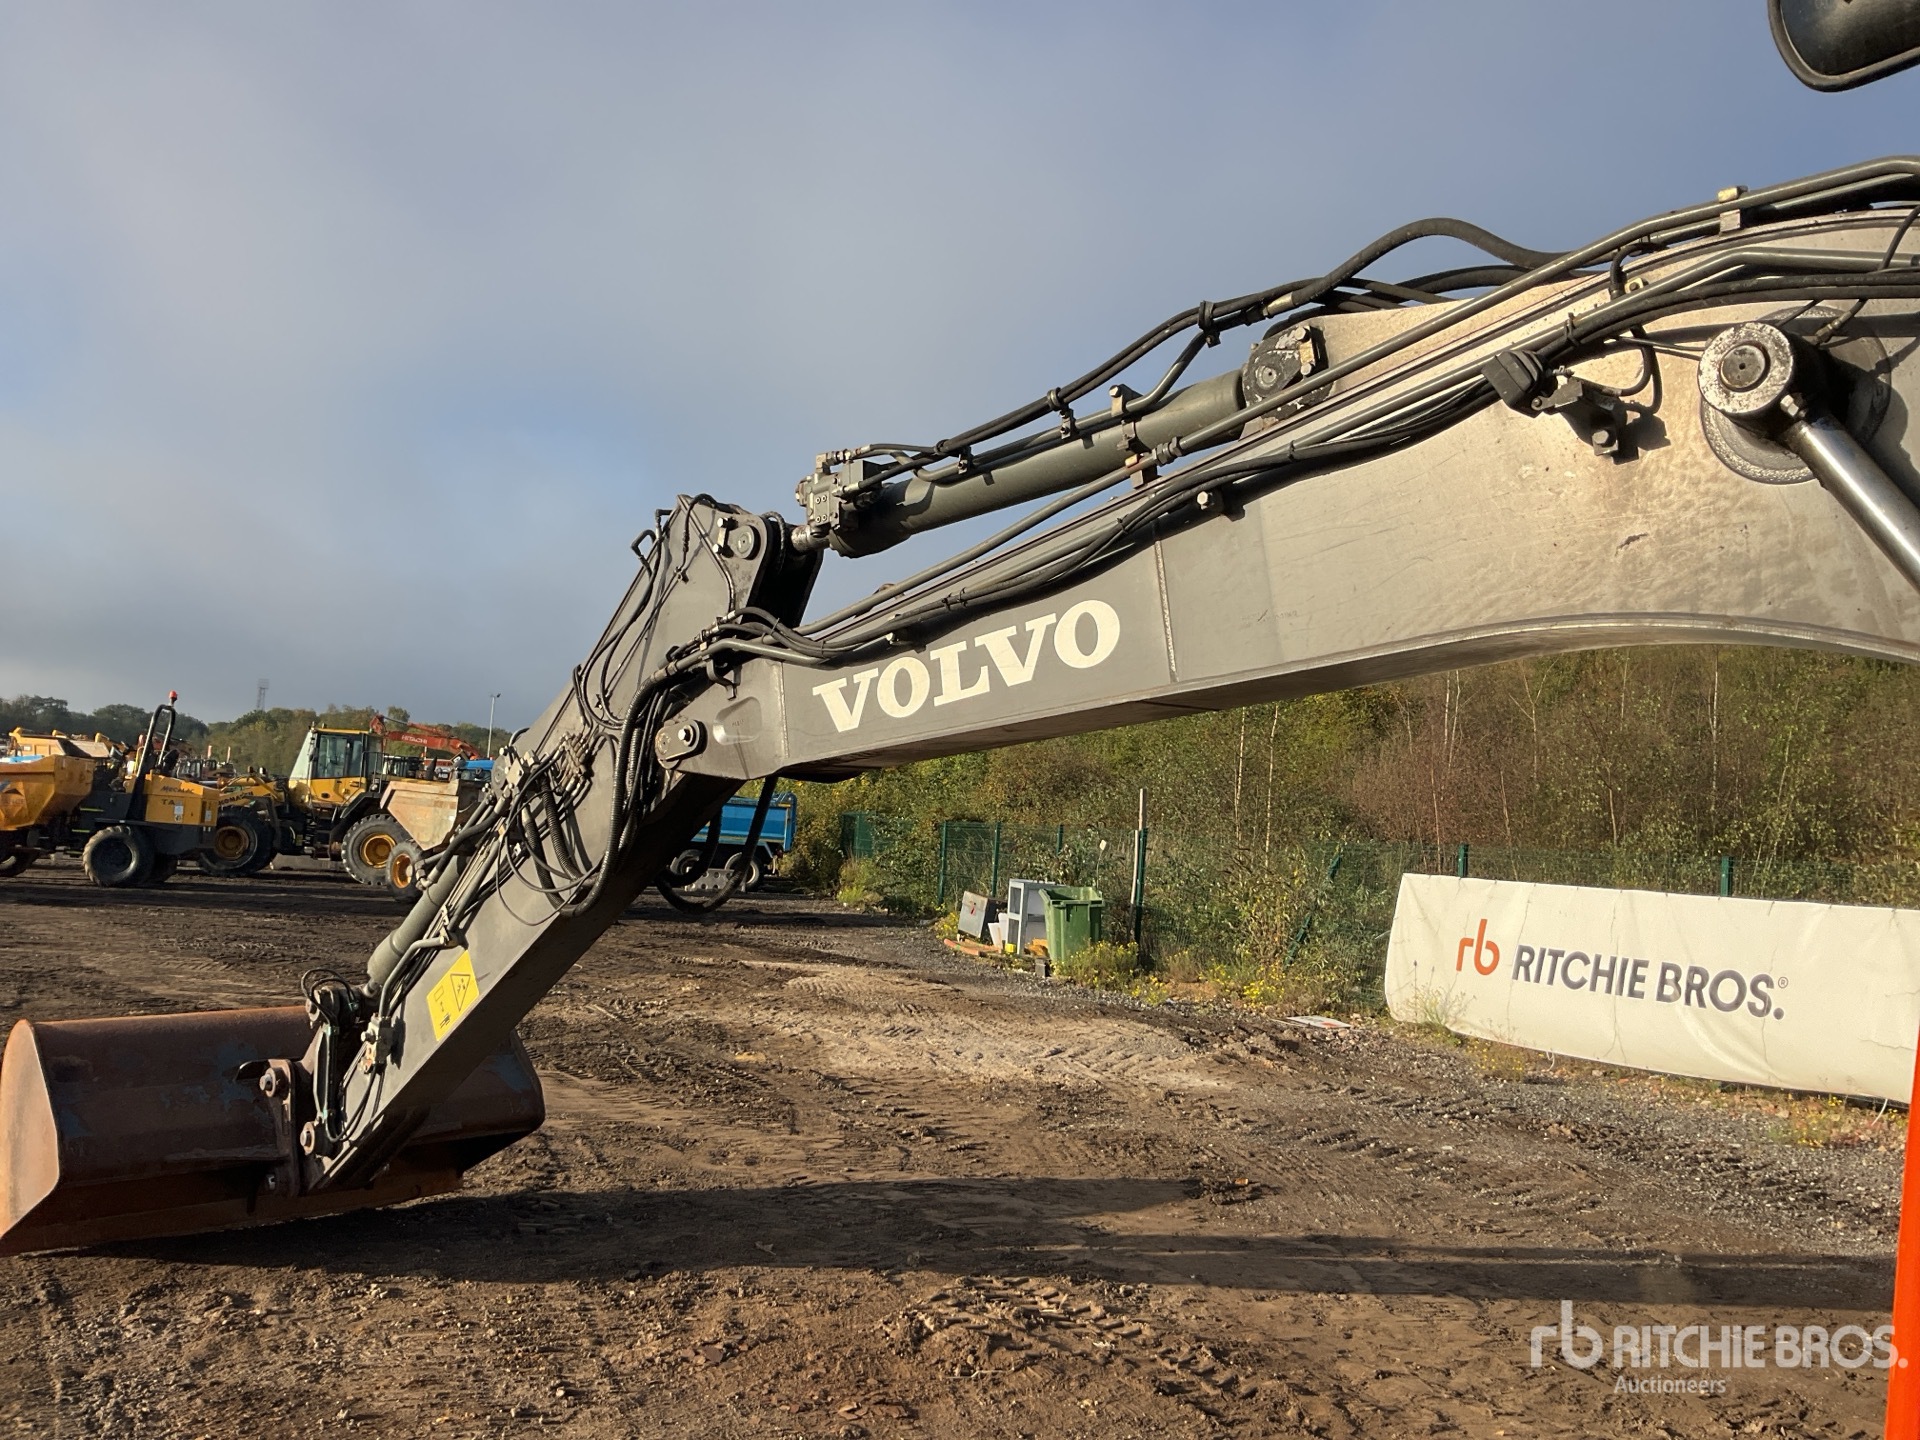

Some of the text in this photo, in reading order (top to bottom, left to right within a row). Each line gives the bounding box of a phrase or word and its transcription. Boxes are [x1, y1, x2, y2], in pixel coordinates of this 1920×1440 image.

[812, 600, 1120, 733] VOLVO
[401, 735, 428, 745] HITACHI
[1456, 918, 1786, 1020] rb RITCHIE BROS.
